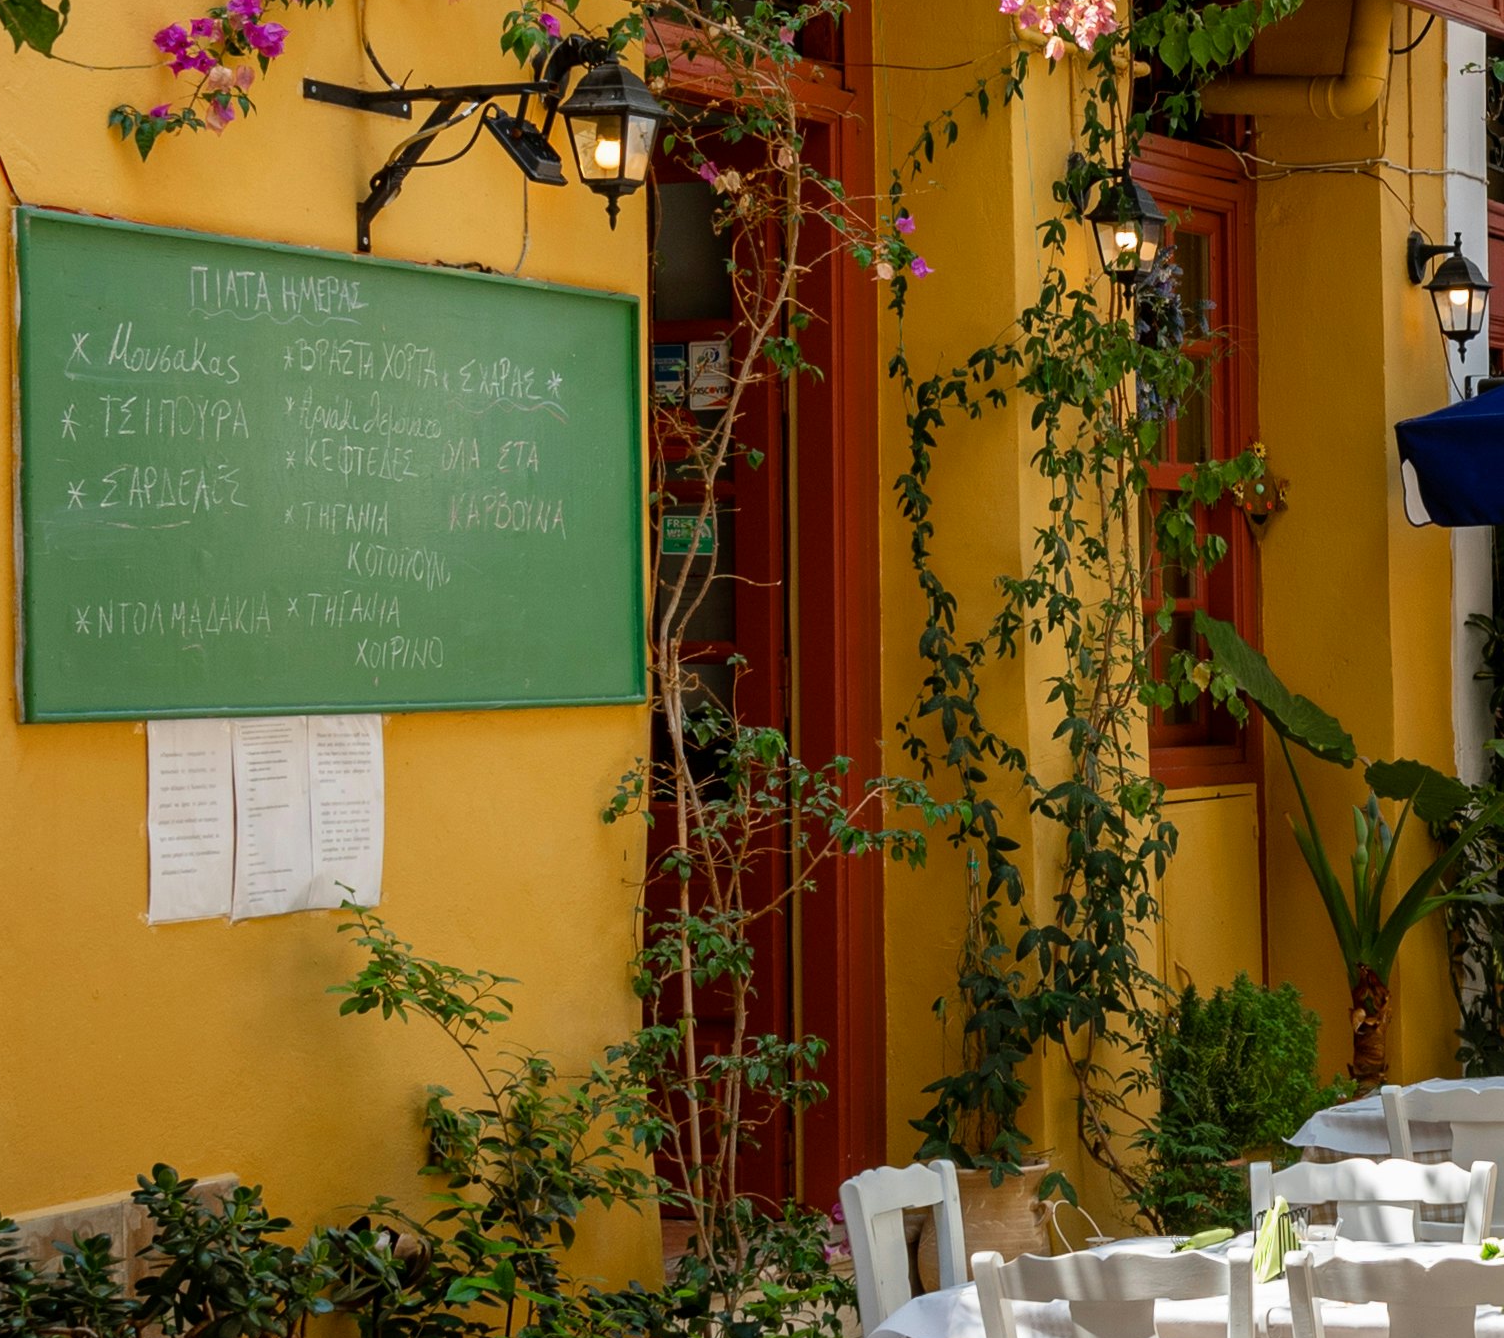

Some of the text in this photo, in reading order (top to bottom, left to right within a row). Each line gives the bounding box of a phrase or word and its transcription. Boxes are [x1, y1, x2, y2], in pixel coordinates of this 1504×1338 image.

[191, 266, 369, 314] ΠΙΑΤΑ ΗΜΕΡΑΣ
[99, 395, 249, 442] ΤΣΙΠΟΥΡΑ
